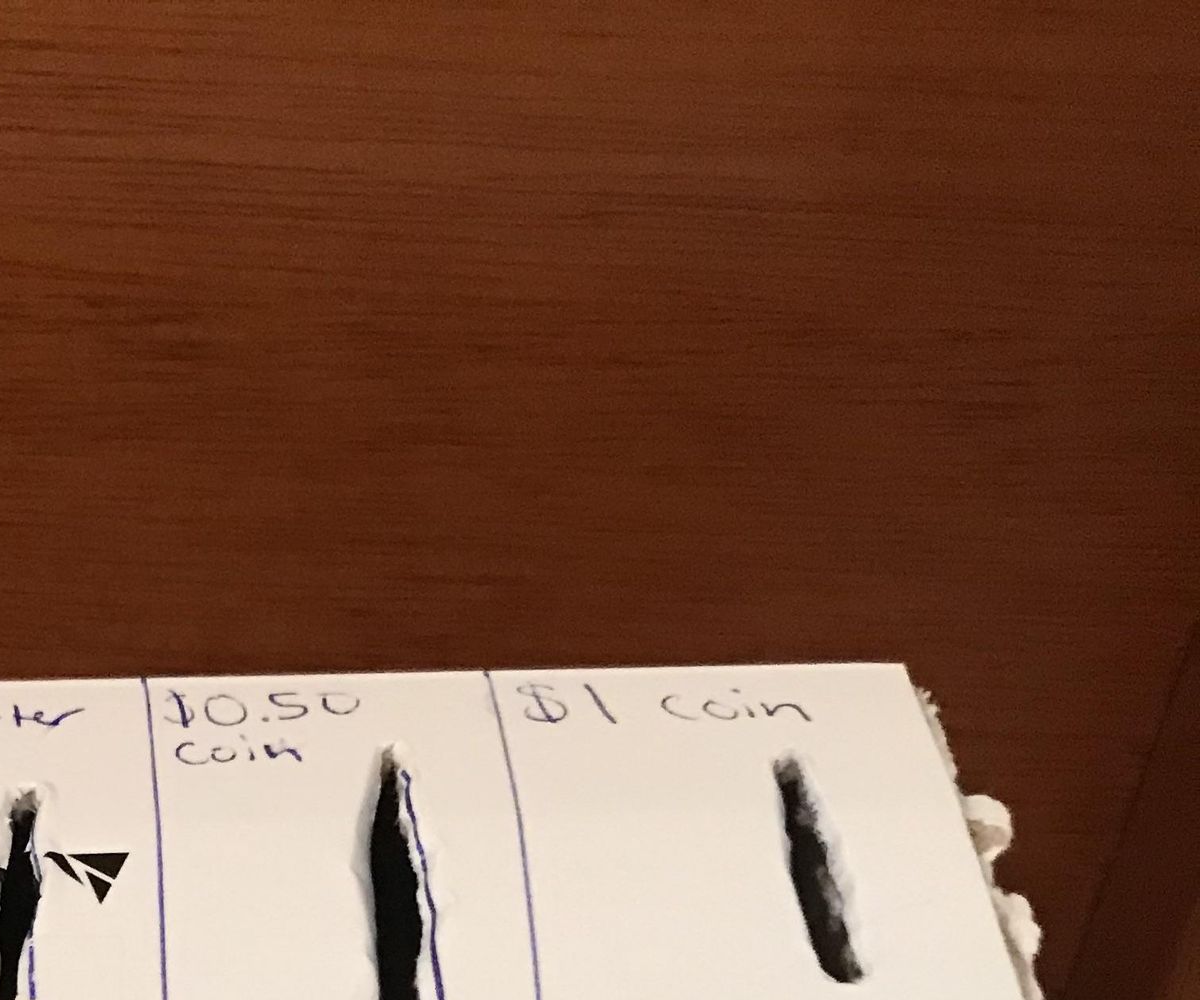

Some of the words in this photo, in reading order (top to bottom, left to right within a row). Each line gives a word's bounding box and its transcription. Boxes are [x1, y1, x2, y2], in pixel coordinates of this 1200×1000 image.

[163, 688, 361, 729] $0.50
[515, 683, 617, 724] $1
[660, 687, 813, 722] coin
[174, 733, 303, 766] coin
